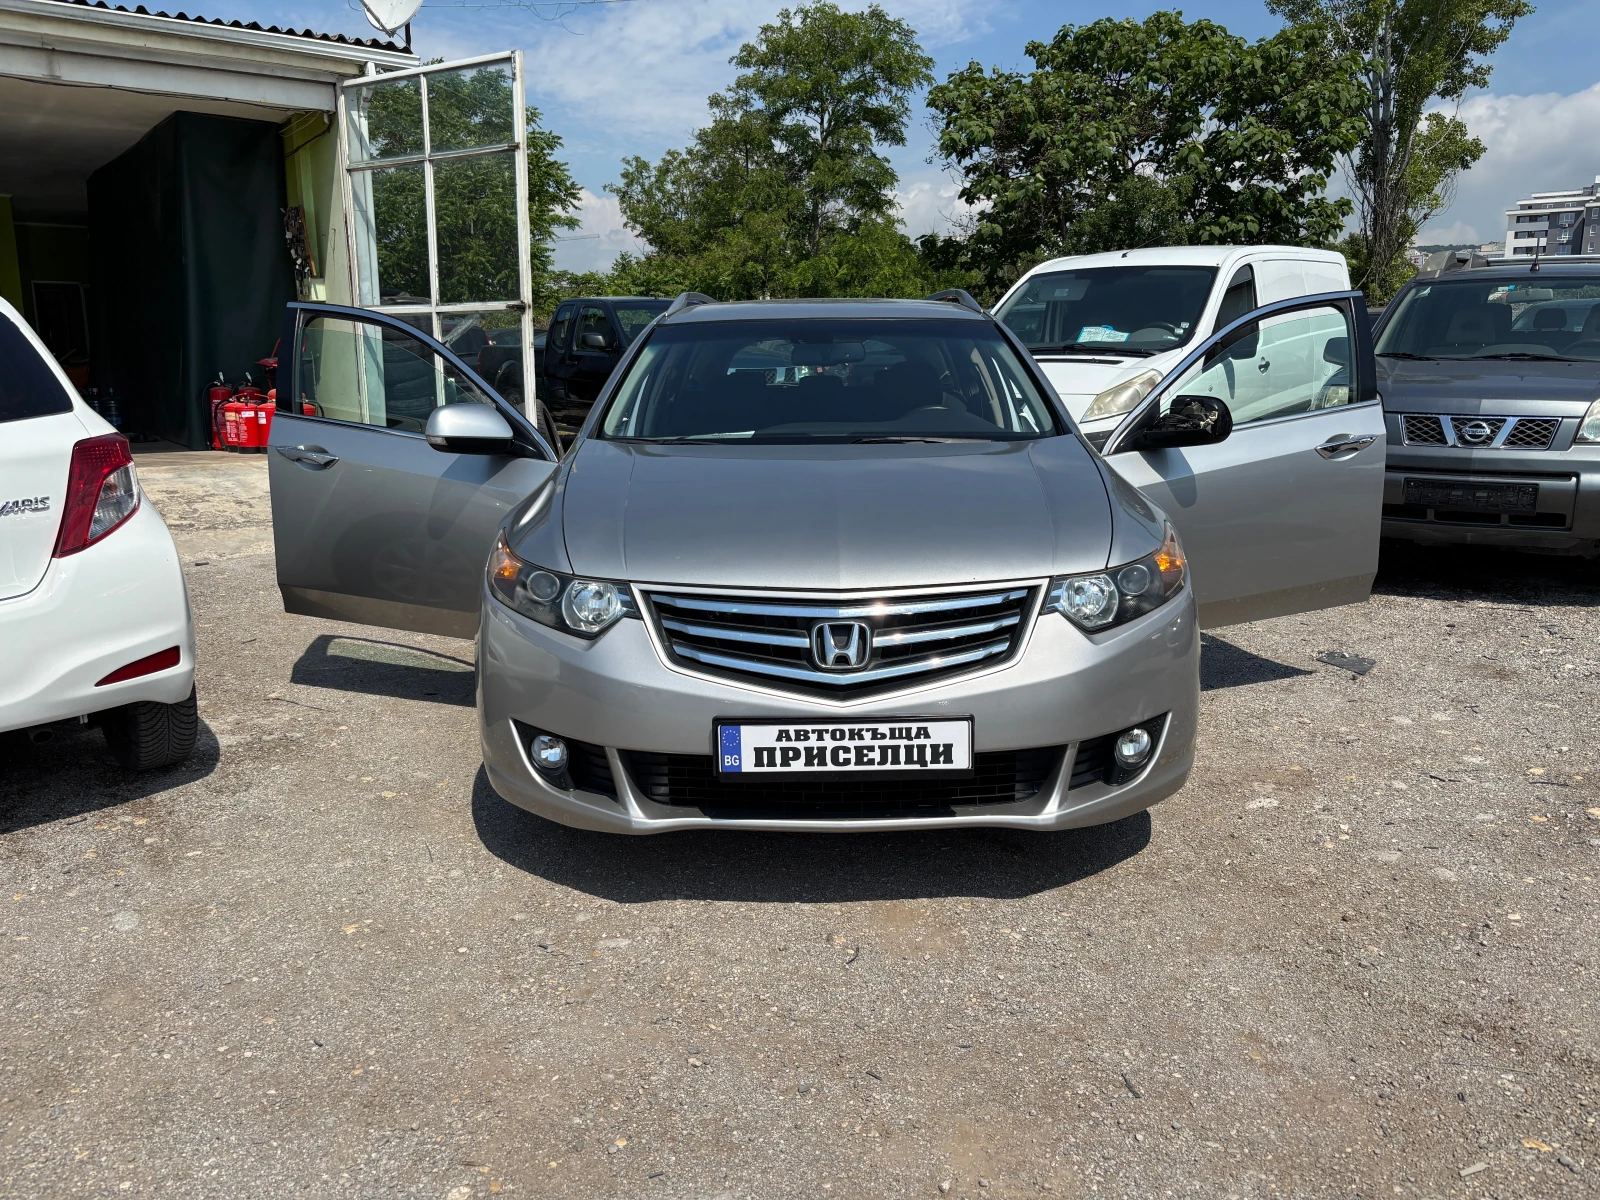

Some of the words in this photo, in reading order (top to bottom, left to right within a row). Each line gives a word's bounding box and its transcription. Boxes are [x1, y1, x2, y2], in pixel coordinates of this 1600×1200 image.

[775, 726, 931, 742] АВТОКЪЩА
[724, 755, 740, 766] BG
[753, 743, 954, 768] ПРИСЕЛЦИ
